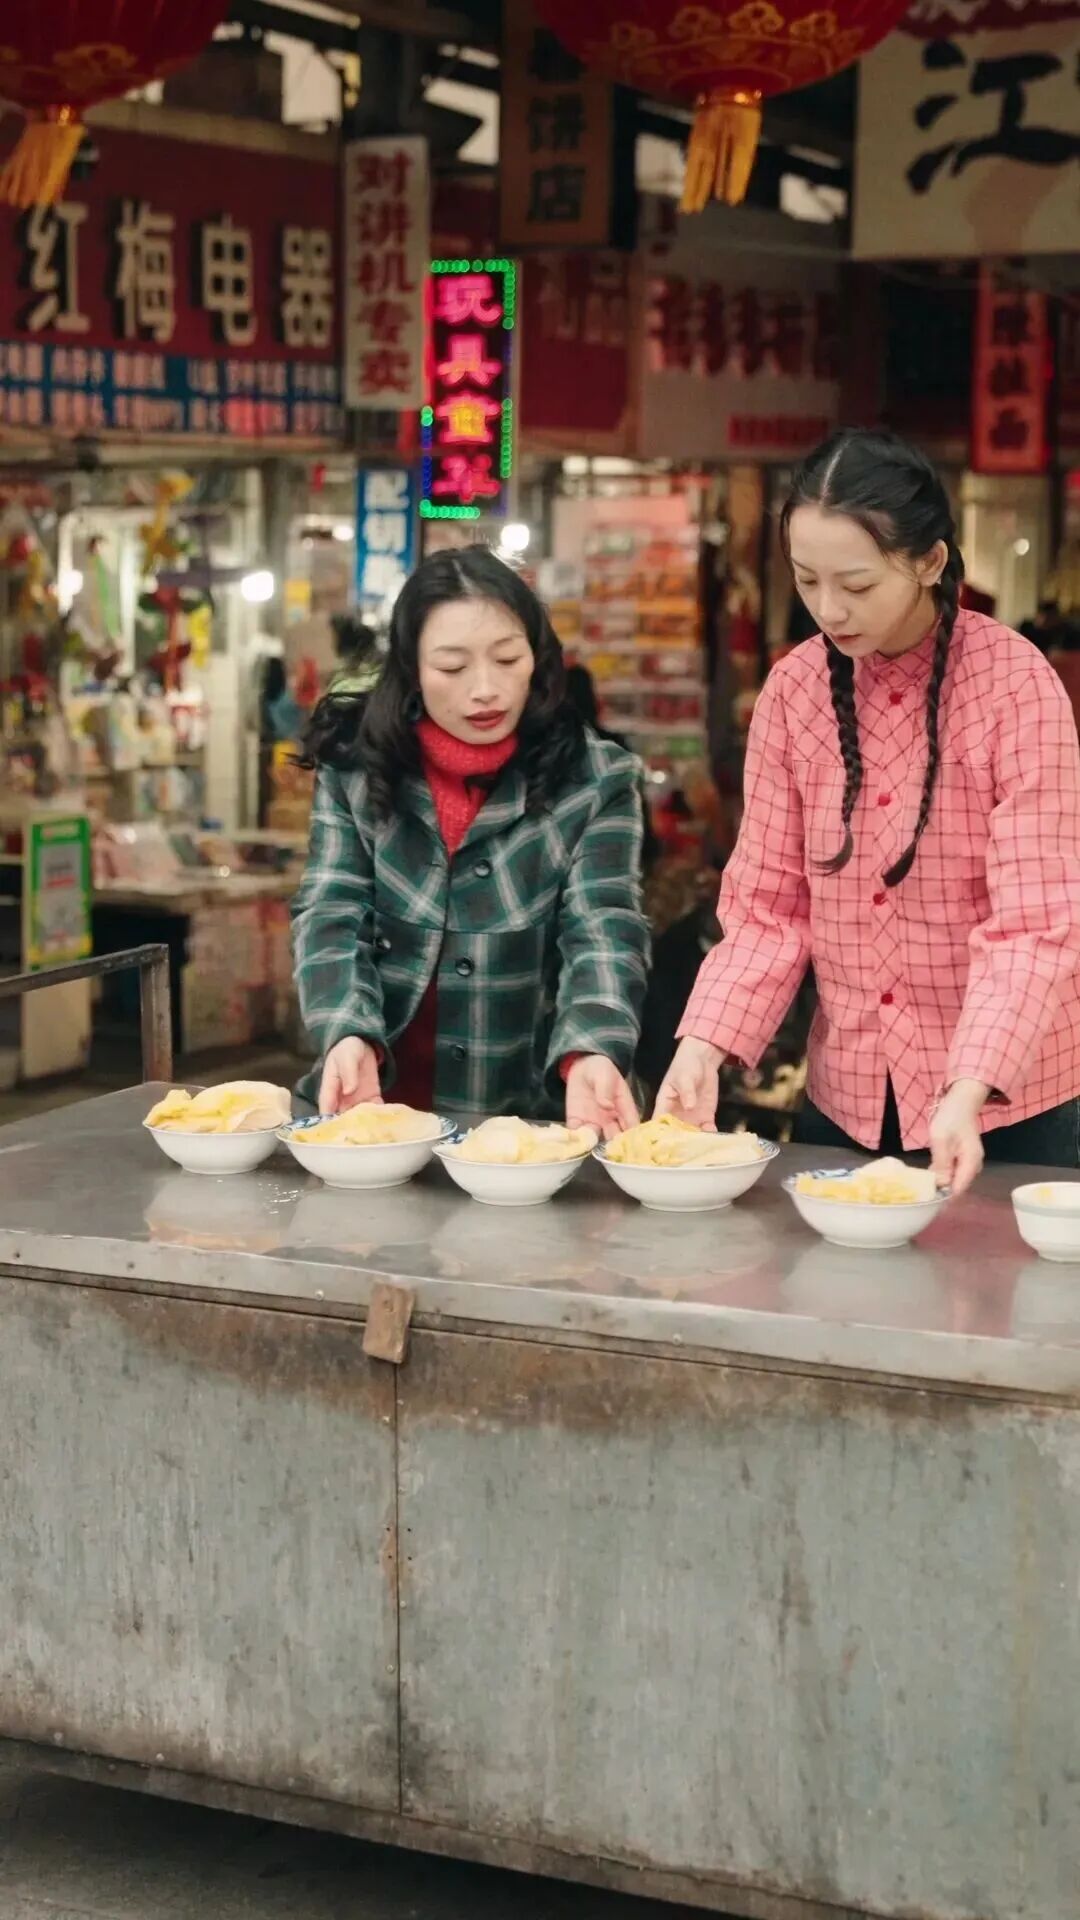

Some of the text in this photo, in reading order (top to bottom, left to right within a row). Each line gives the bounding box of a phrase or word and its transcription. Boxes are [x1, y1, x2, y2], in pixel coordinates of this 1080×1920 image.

[26, 200, 334, 347] 红梅电器
[354, 151, 415, 396] 对讲机专卖
